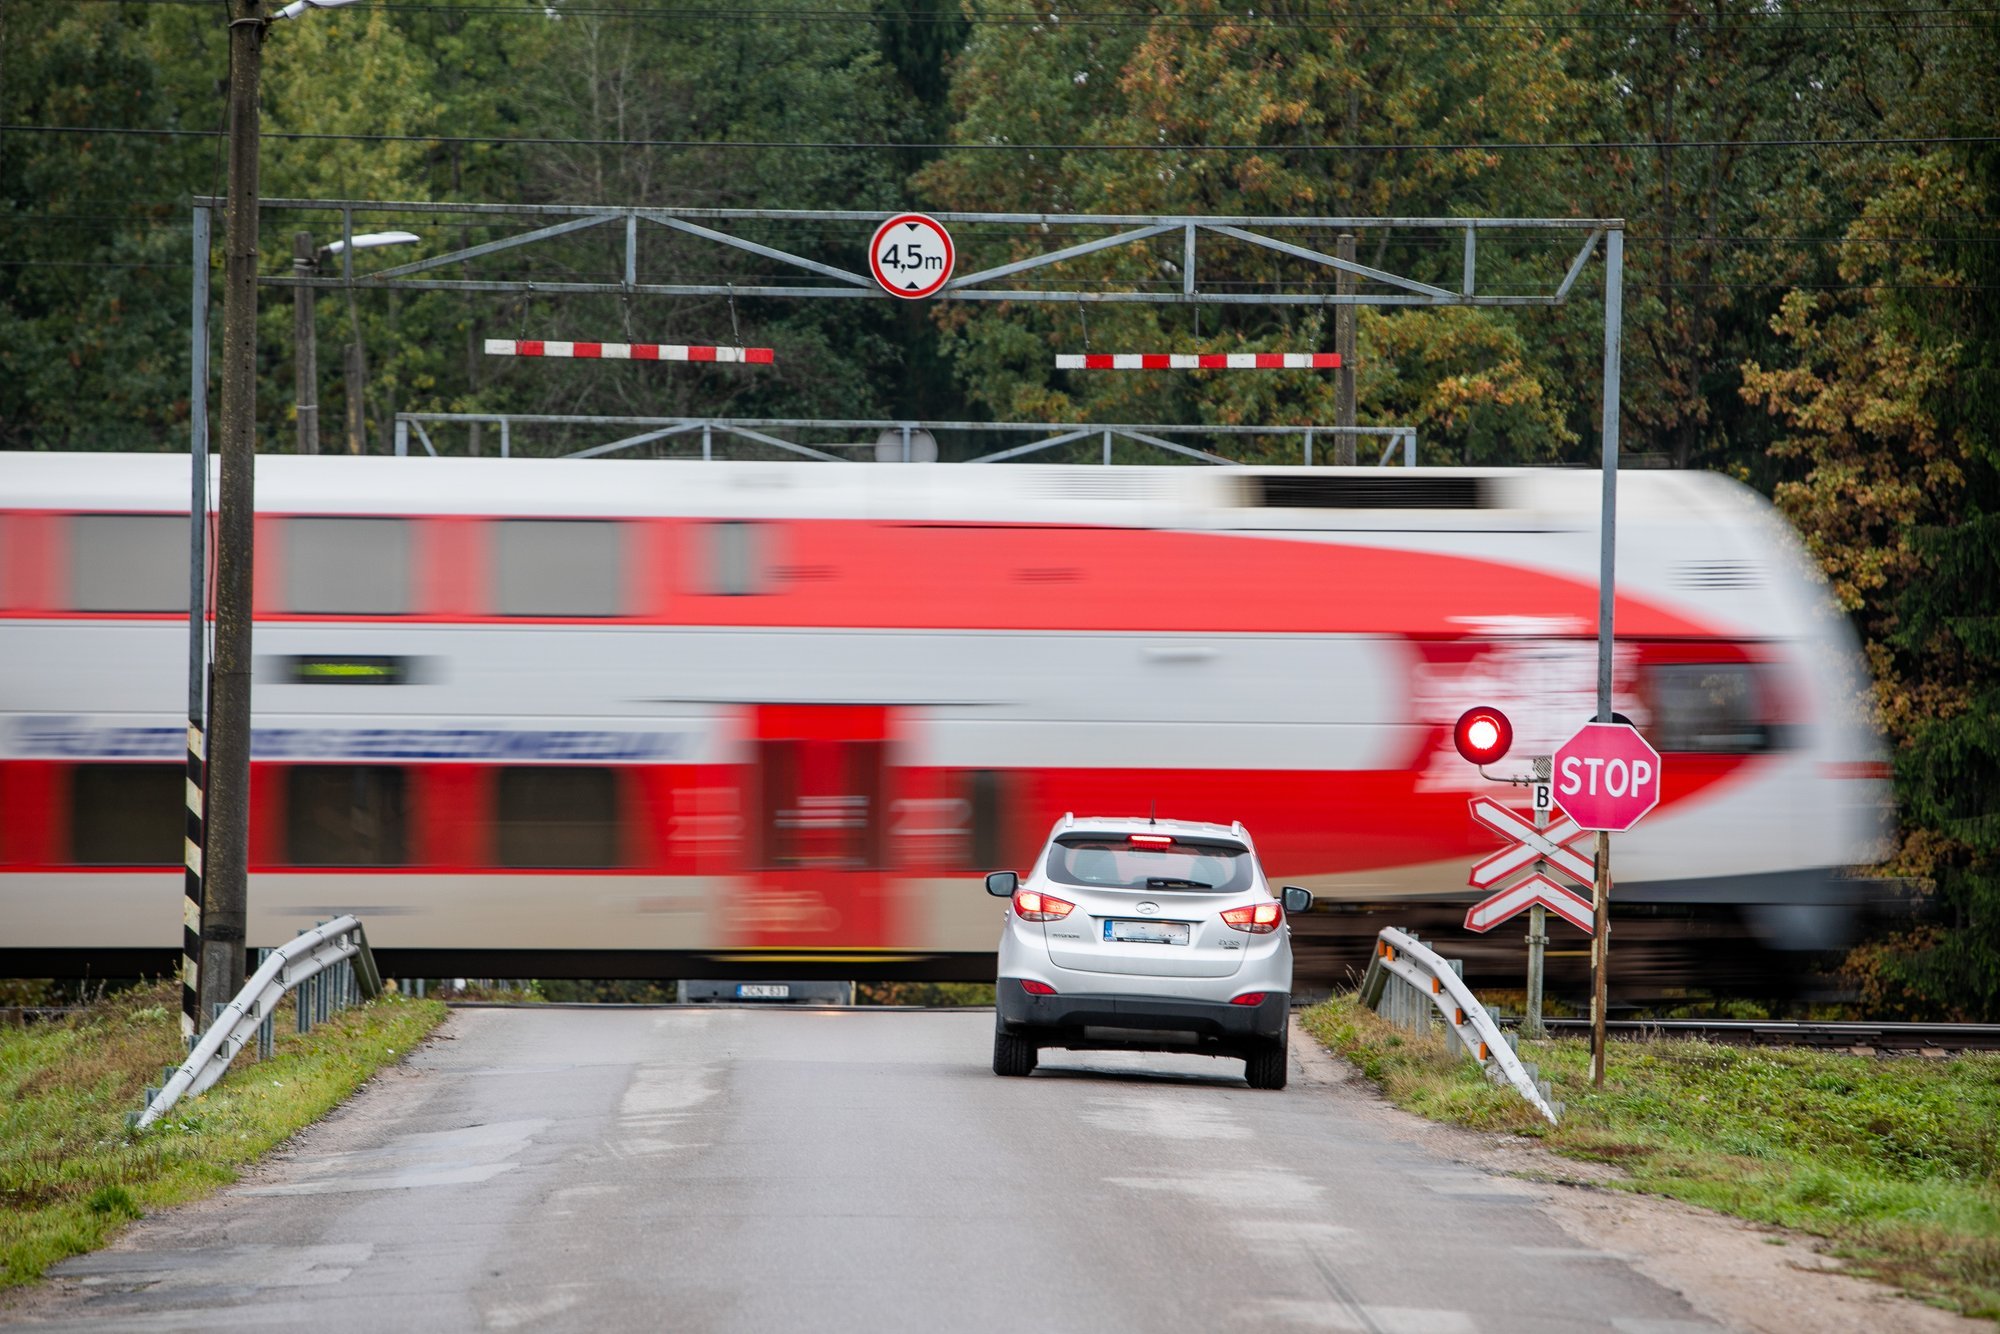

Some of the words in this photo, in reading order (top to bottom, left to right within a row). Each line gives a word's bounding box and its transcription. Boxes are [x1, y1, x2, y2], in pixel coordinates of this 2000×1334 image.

[881, 243, 942, 274] 4,5m
[1559, 756, 1652, 798] STOP
[1537, 786, 1549, 807] B
